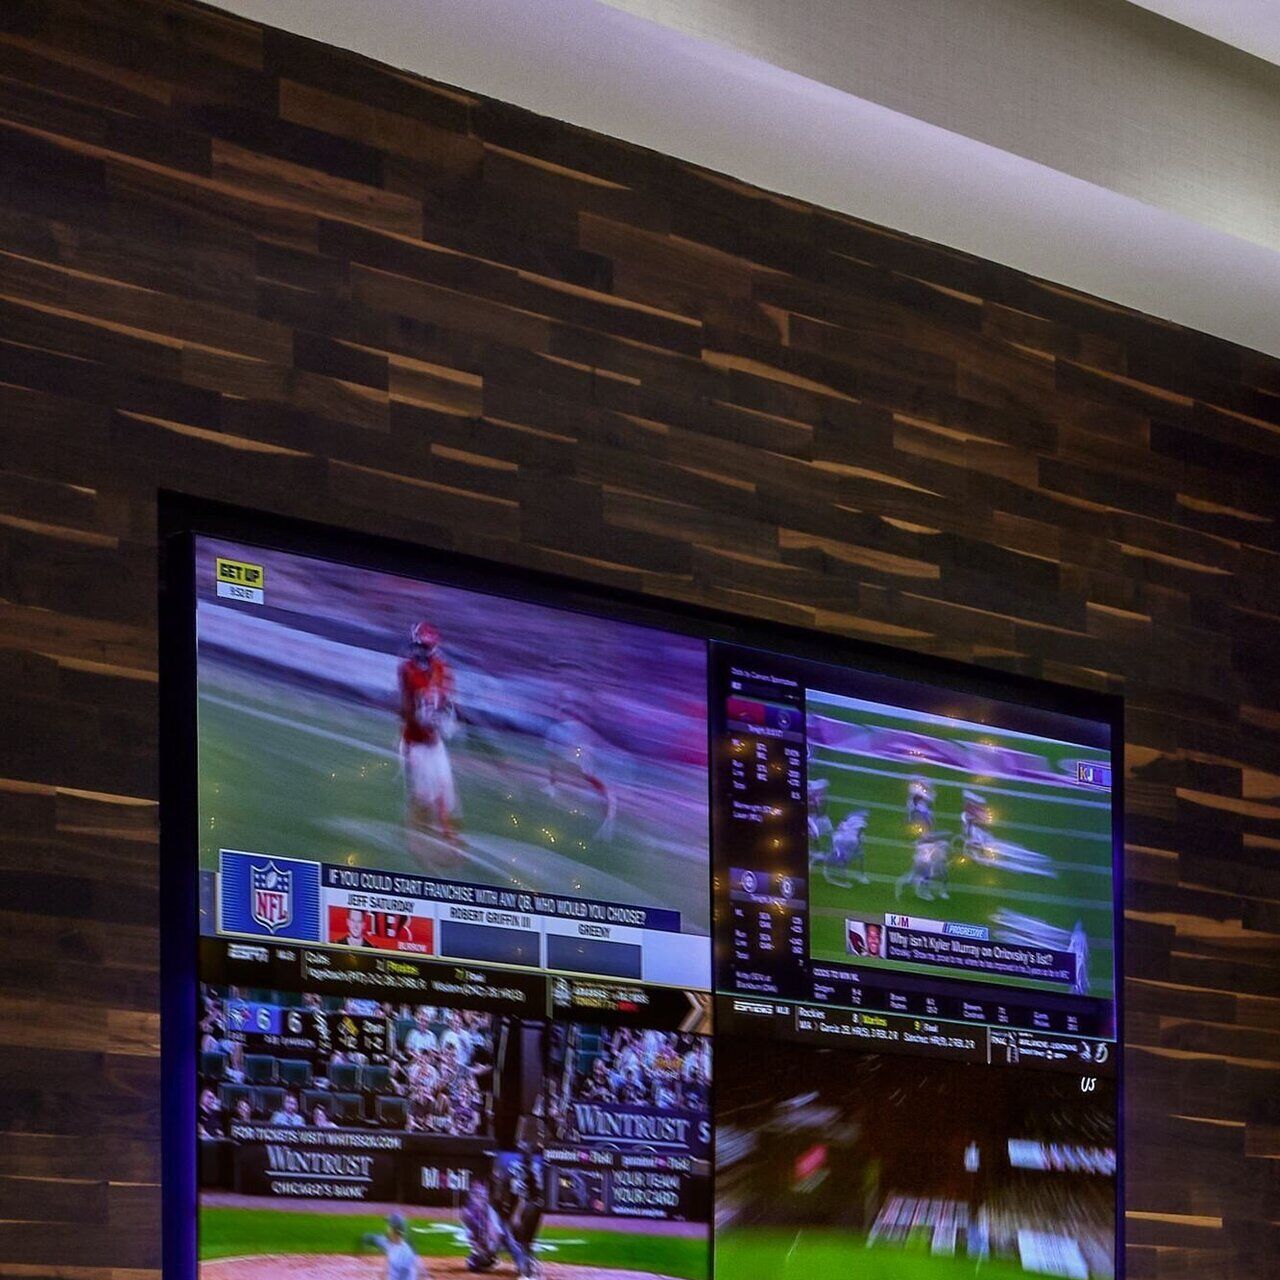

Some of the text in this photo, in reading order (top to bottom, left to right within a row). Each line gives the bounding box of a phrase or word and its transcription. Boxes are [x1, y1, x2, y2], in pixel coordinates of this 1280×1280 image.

[220, 562, 243, 581] GET
[256, 891, 289, 922] NFL
[329, 869, 339, 883] IF
[339, 870, 359, 885] YOU
[360, 873, 392, 891] COULD
[394, 878, 423, 896] START
[424, 881, 475, 903] FRANCHISE
[475, 888, 498, 906] WITH
[499, 891, 517, 907] ANY
[534, 897, 556, 913] WHO
[557, 900, 587, 918] WOULD
[588, 903, 606, 920] YOU
[607, 907, 647, 926] CHOOSE?
[348, 894, 414, 913] JEFF SATURDAY
[450, 907, 485, 922] ROBERT
[486, 911, 520, 927] GRIFFIN
[889, 931, 907, 949] Why
[928, 936, 950, 953] Kyler
[952, 940, 979, 958] Murray
[574, 1104, 691, 1143] WINTRUST
[266, 1145, 374, 1177] WINTRUST
